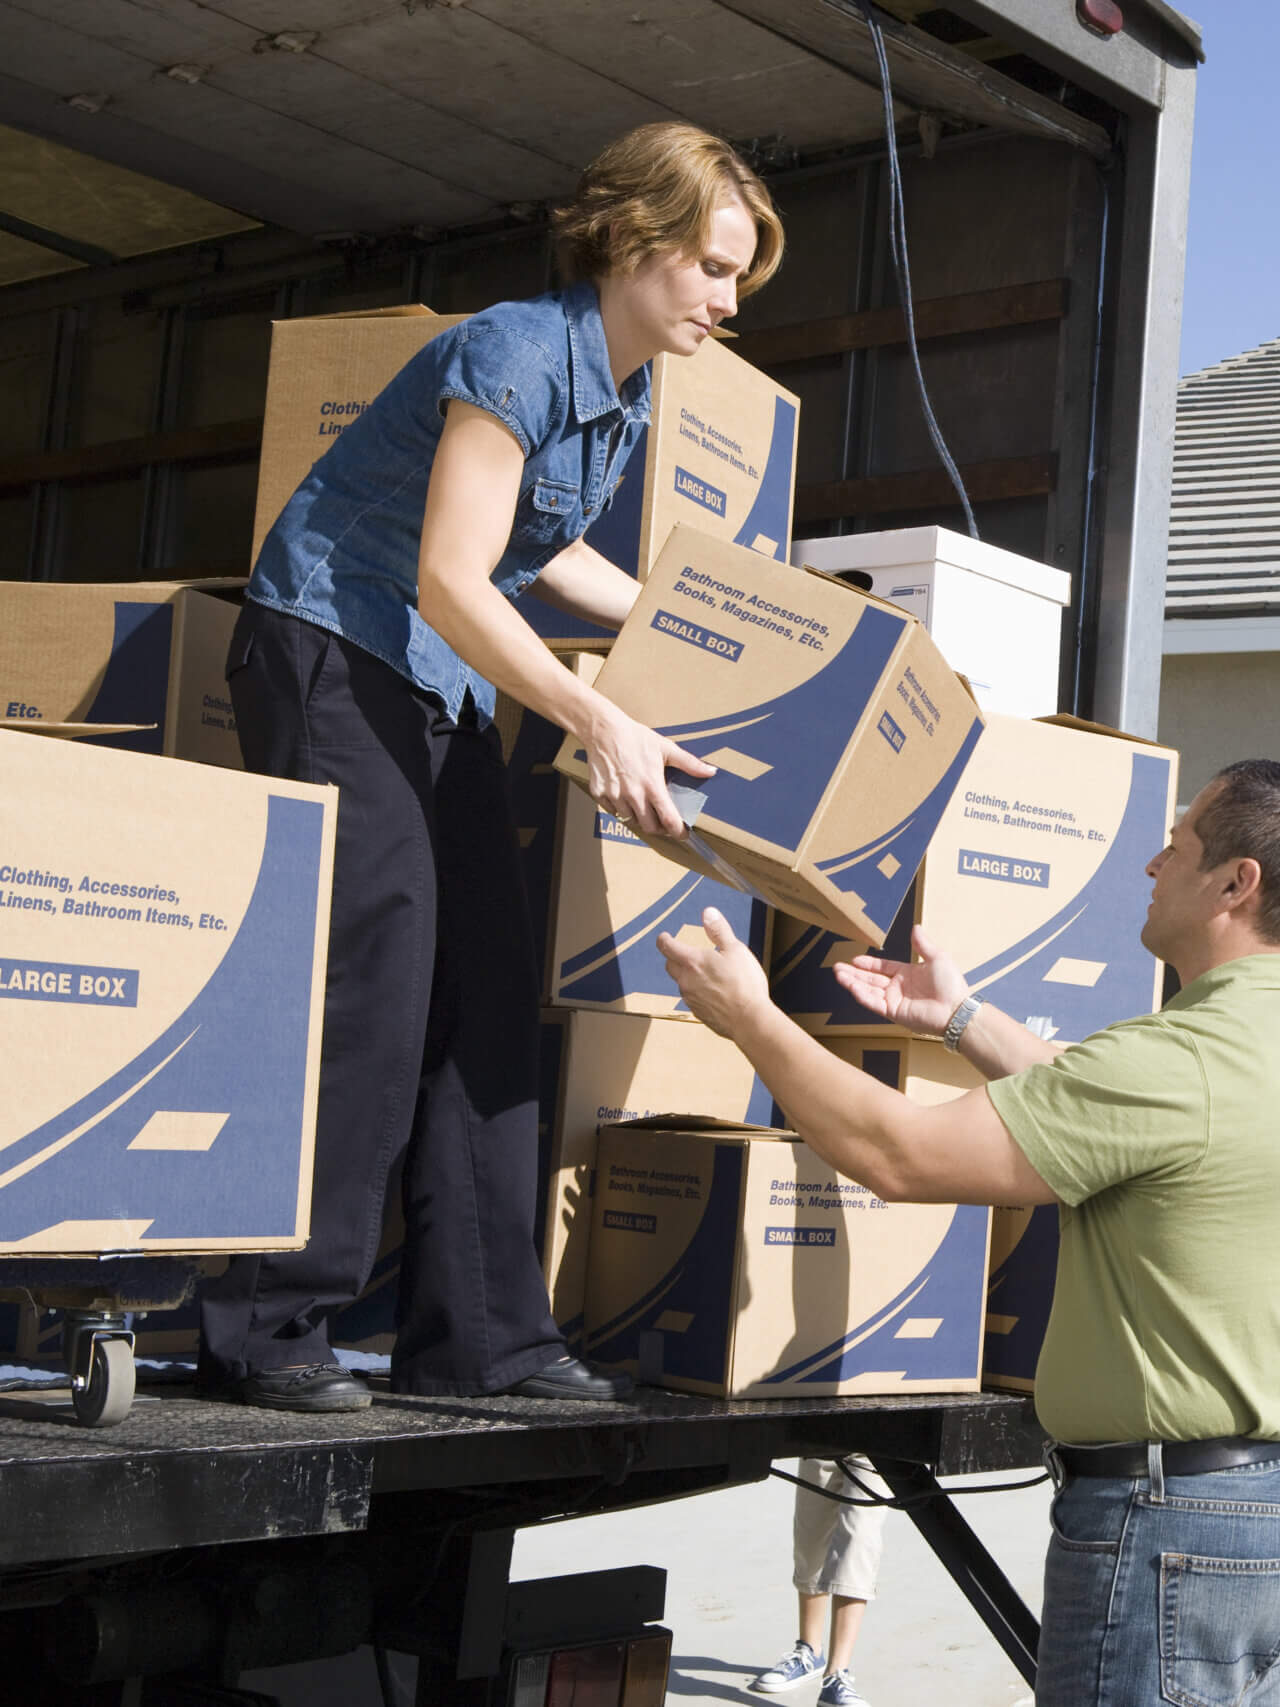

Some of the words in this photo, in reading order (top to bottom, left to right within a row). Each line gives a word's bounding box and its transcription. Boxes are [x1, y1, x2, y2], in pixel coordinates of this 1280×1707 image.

[320, 401, 371, 415] Clothi
[680, 408, 706, 434] Clothing,
[701, 437, 729, 462] Bathroom
[677, 473, 704, 500] LARGE
[705, 490, 723, 511] BOX
[680, 566, 745, 601] Bathroom
[746, 594, 830, 638] Accessories,
[673, 580, 717, 609] Books,
[720, 600, 795, 641] Magazines,
[798, 632, 825, 651] Etc.
[657, 615, 703, 643] SMALL
[705, 636, 739, 657] BOX
[6, 701, 43, 719] Etc.
[965, 791, 1010, 811] Clothing,
[1012, 800, 1076, 823] Accessories,
[964, 807, 1000, 824] Linens,
[1003, 814, 1052, 832] Bathroom
[1053, 823, 1085, 840] Items,
[1087, 829, 1107, 843] Etc.
[962, 855, 1010, 877] LARGE
[1013, 864, 1043, 882] BOX
[0, 866, 73, 893] Clothing,
[78, 876, 180, 906] Accessories,
[62, 898, 142, 922] Bathroom
[146, 907, 194, 930] Items,
[198, 913, 228, 931] Etc.
[79, 975, 127, 999] BOX
[597, 1106, 638, 1120] Clothing
[770, 1180, 822, 1193] Bathroom
[824, 1182, 869, 1194] Accesso
[769, 1195, 804, 1208] Books,
[808, 1196, 866, 1210] Magazines,
[869, 1198, 889, 1209] Etc.
[768, 1230, 805, 1243] SMALL
[808, 1231, 832, 1243] BOX
